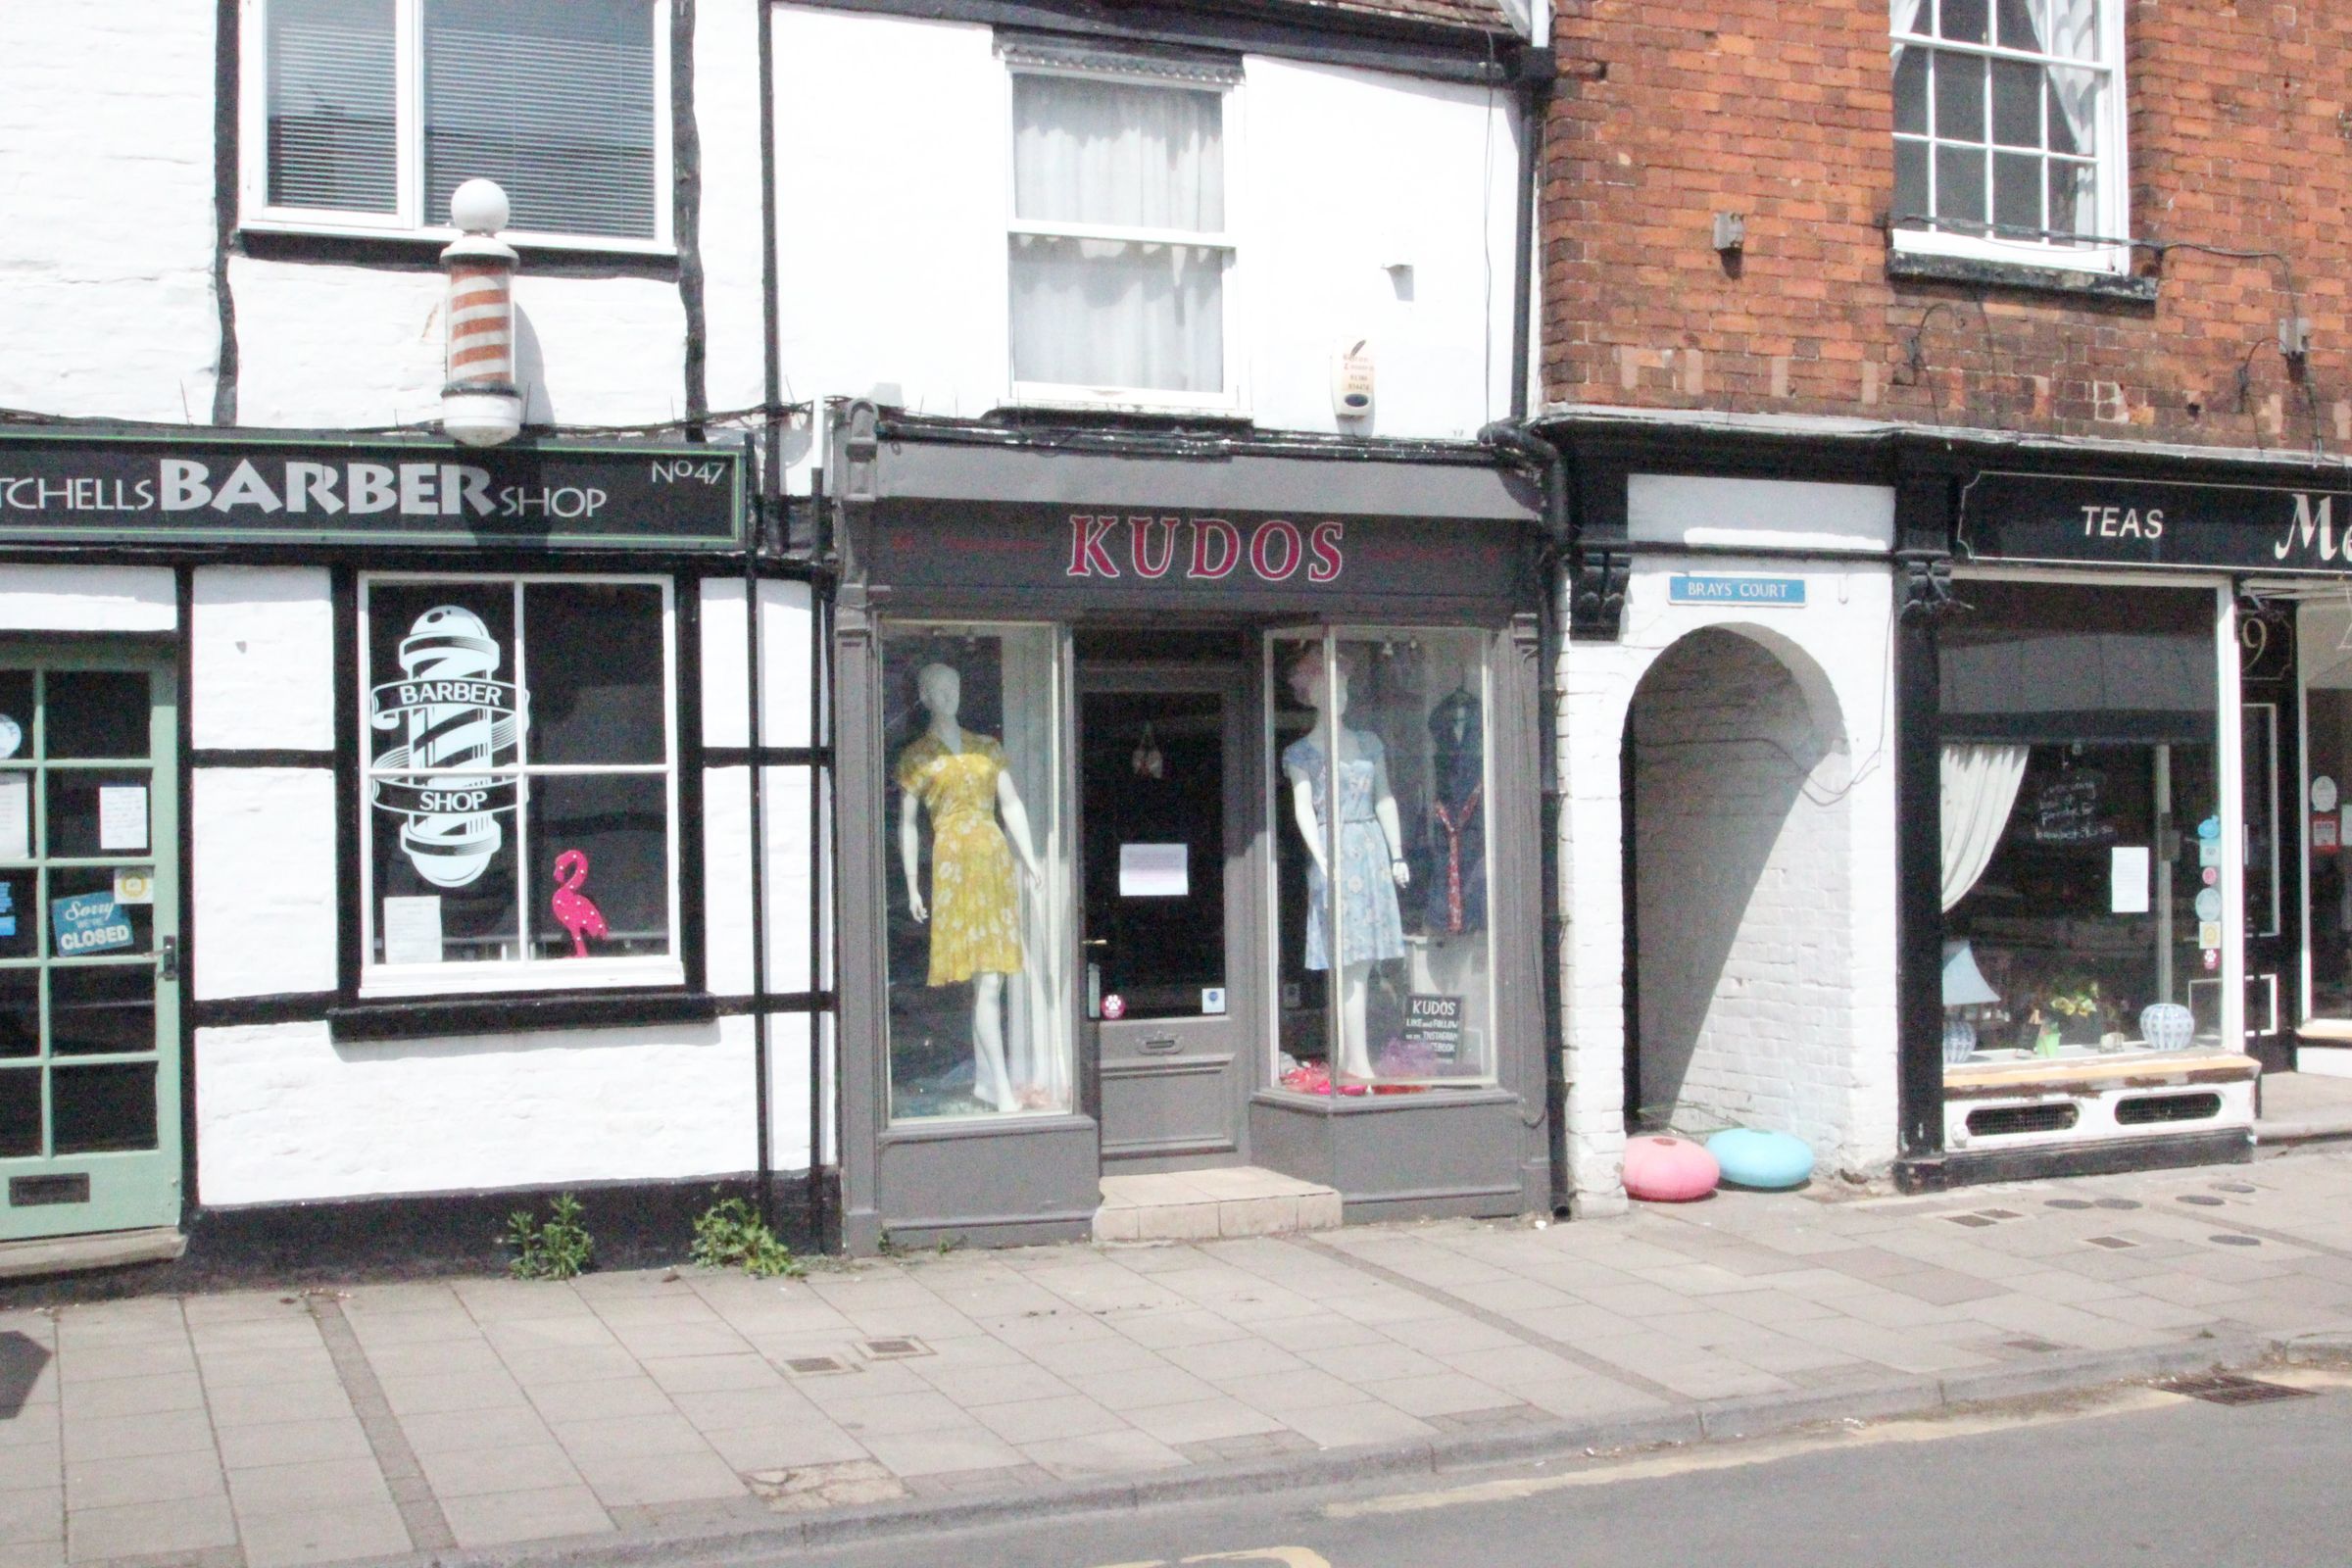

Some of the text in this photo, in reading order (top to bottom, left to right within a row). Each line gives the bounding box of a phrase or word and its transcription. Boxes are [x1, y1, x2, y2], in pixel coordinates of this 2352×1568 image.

[160, 458, 497, 517] BARBER
[500, 486, 607, 518] SHOP
[2081, 505, 2164, 539] TEAS
[1066, 514, 1344, 582] KUDOS
[1688, 581, 1788, 598] BRAYS COURT
[399, 681, 502, 707] BARBER
[419, 791, 488, 812] SHOP
[65, 901, 114, 921] Sorry
[61, 924, 129, 951] CLOSED
[1412, 1001, 1456, 1015] KUDOS
